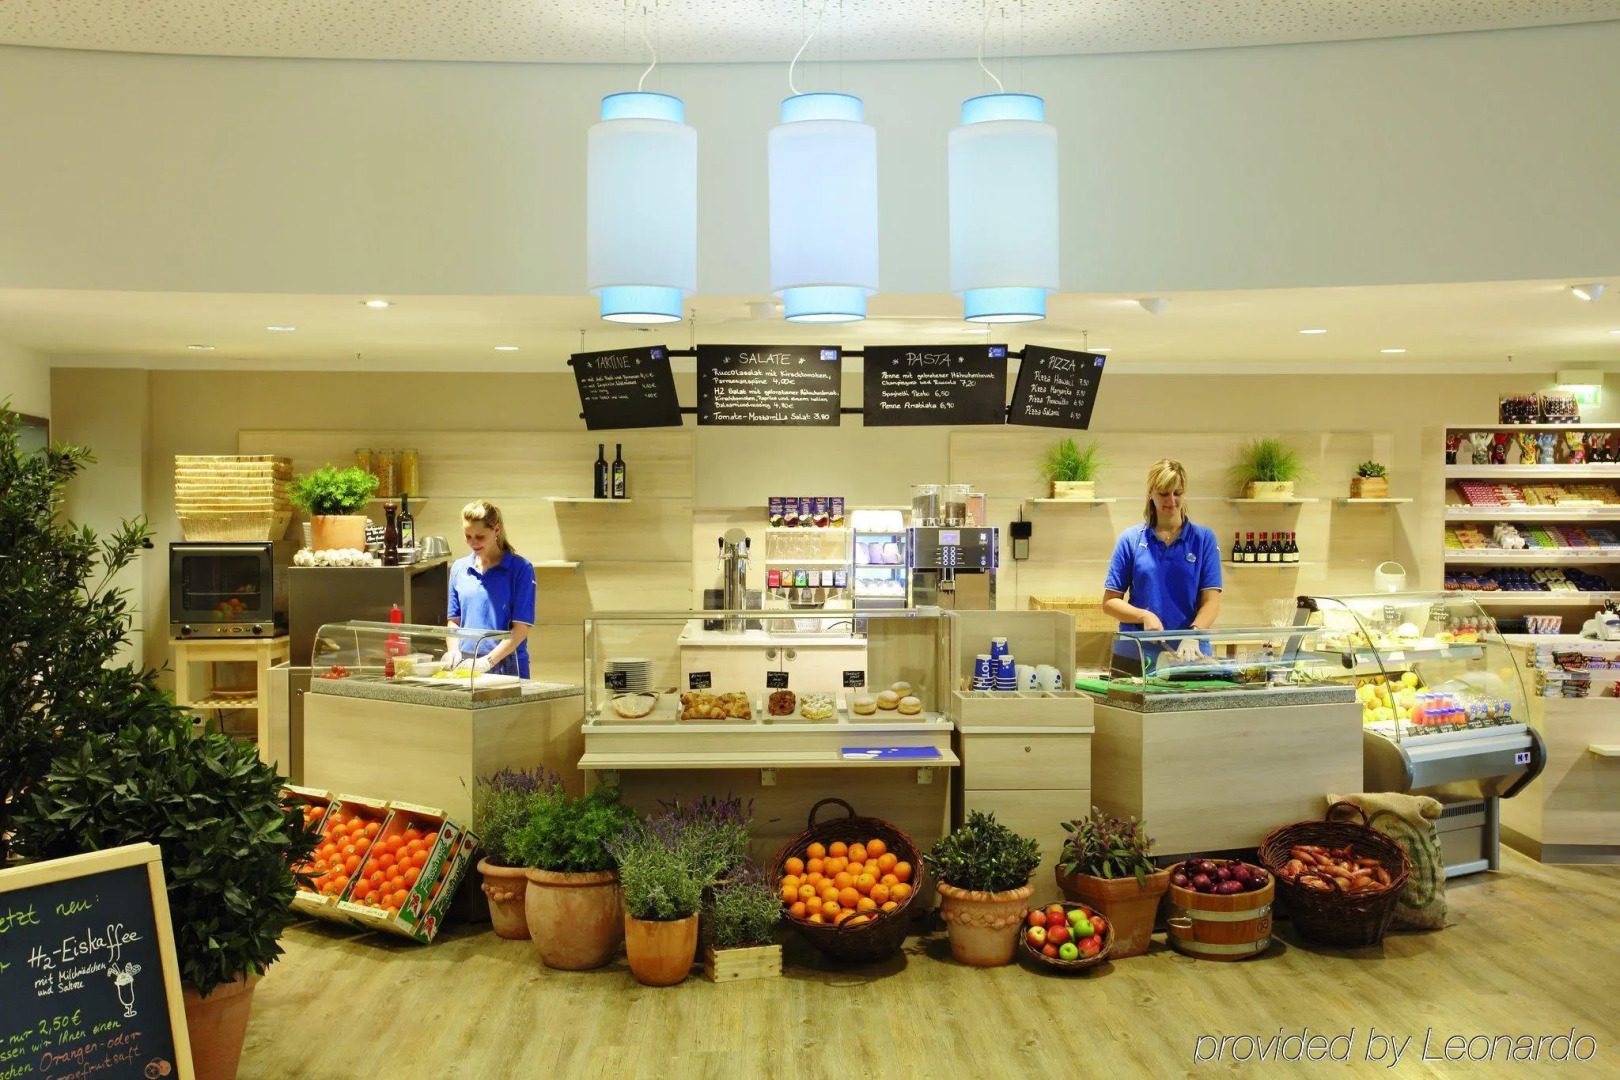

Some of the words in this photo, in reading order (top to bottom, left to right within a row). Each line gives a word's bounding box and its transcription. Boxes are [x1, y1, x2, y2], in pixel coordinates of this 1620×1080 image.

[595, 355, 631, 369] TARTINE
[739, 353, 791, 365] SALATE
[906, 352, 951, 367] PASTA
[1048, 355, 1076, 372] PIZZA
[766, 369, 777, 377] mit
[881, 371, 900, 379] Penne
[1034, 370, 1051, 382] Pizza
[773, 378, 796, 386] 4,00€
[960, 380, 976, 388] 7,20
[1030, 383, 1047, 393] Pizza
[714, 387, 725, 395] H2
[880, 401, 901, 409] Penne
[1028, 394, 1044, 404] Pizza
[1025, 404, 1041, 416] Pizza
[1042, 407, 1060, 416] Salami
[35, 973, 53, 989] mit
[38, 985, 53, 997] und
[58, 980, 85, 993] Sahne
[10, 1030, 33, 1044] nur
[31, 1039, 52, 1052] wir
[58, 1029, 86, 1046] Ihnen
[93, 1020, 121, 1034] einen
